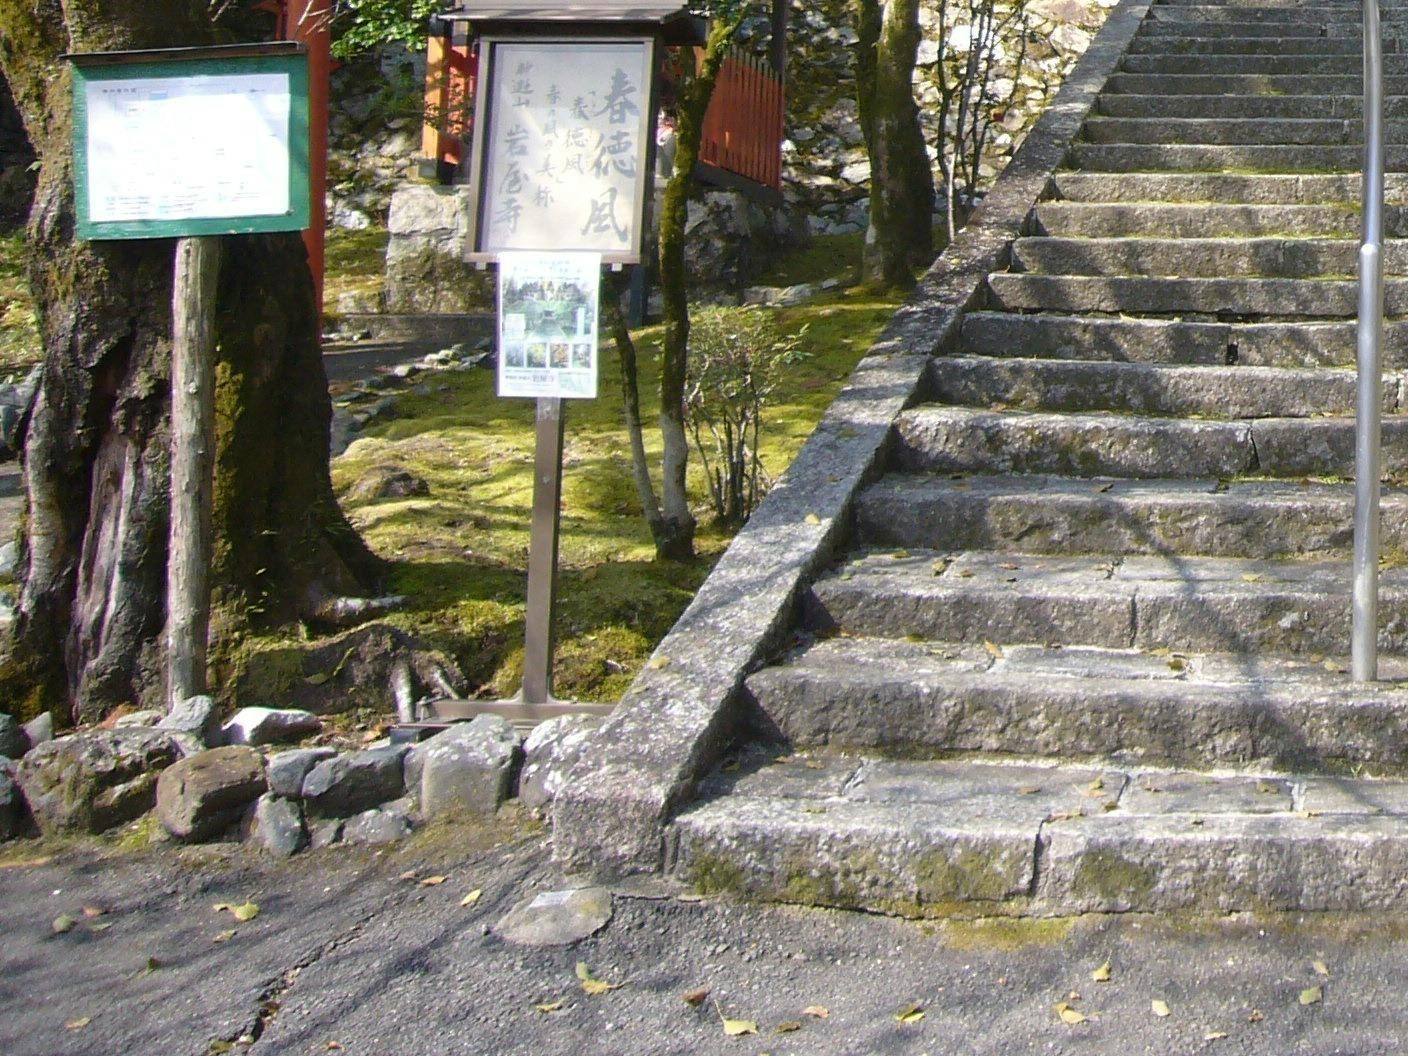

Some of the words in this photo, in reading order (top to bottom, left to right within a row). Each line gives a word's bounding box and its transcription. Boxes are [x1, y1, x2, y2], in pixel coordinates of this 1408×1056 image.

[493, 122, 530, 234] 岩屋寺
[581, 67, 641, 242] 春徳風
